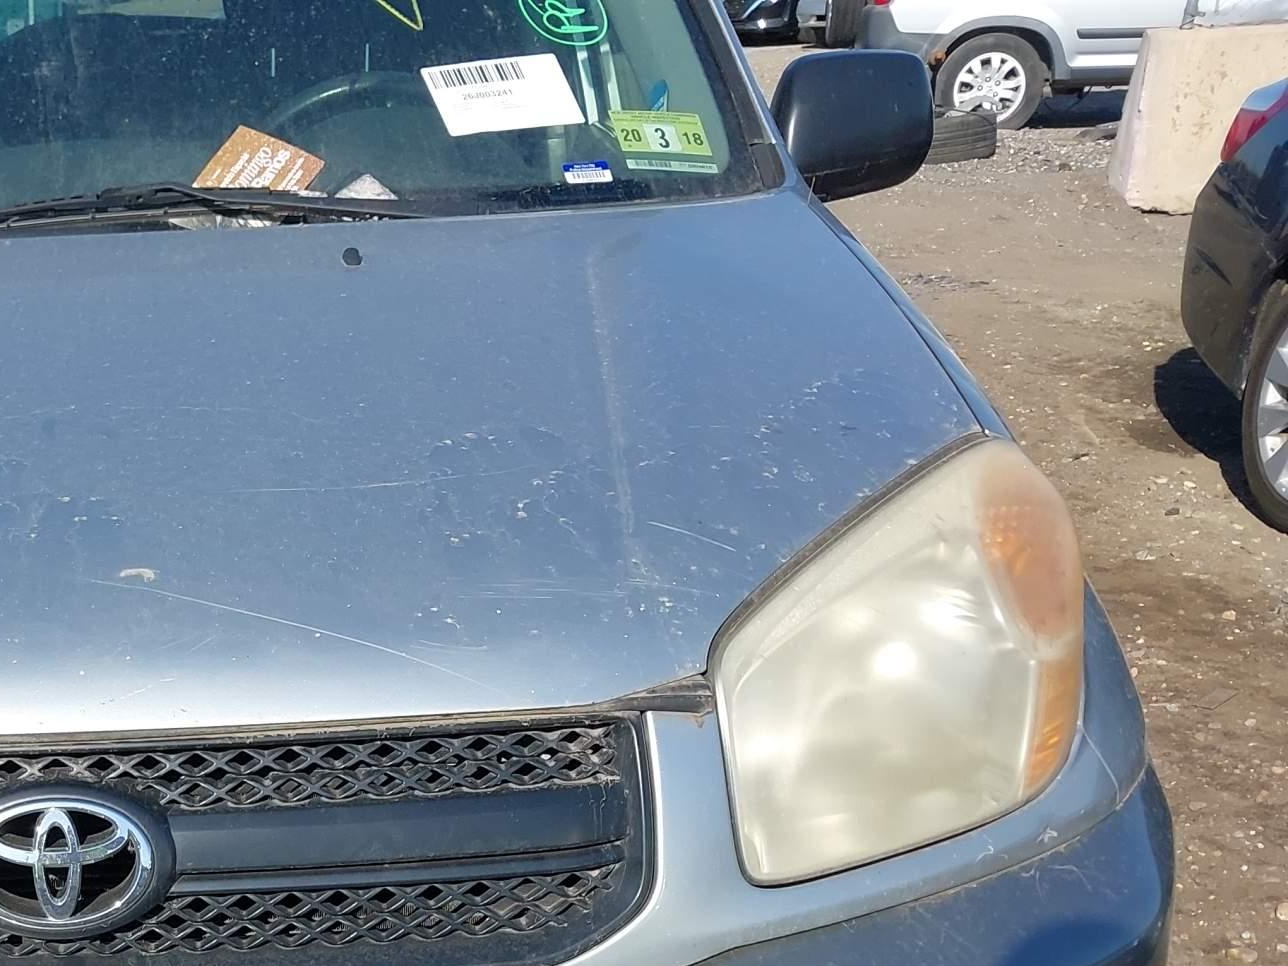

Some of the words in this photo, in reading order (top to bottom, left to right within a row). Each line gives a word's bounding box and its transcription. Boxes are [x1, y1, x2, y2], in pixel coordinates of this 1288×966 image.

[620, 128, 642, 143] 20
[654, 127, 670, 149] 3
[682, 131, 704, 146] 18
[229, 146, 272, 189] omingo
